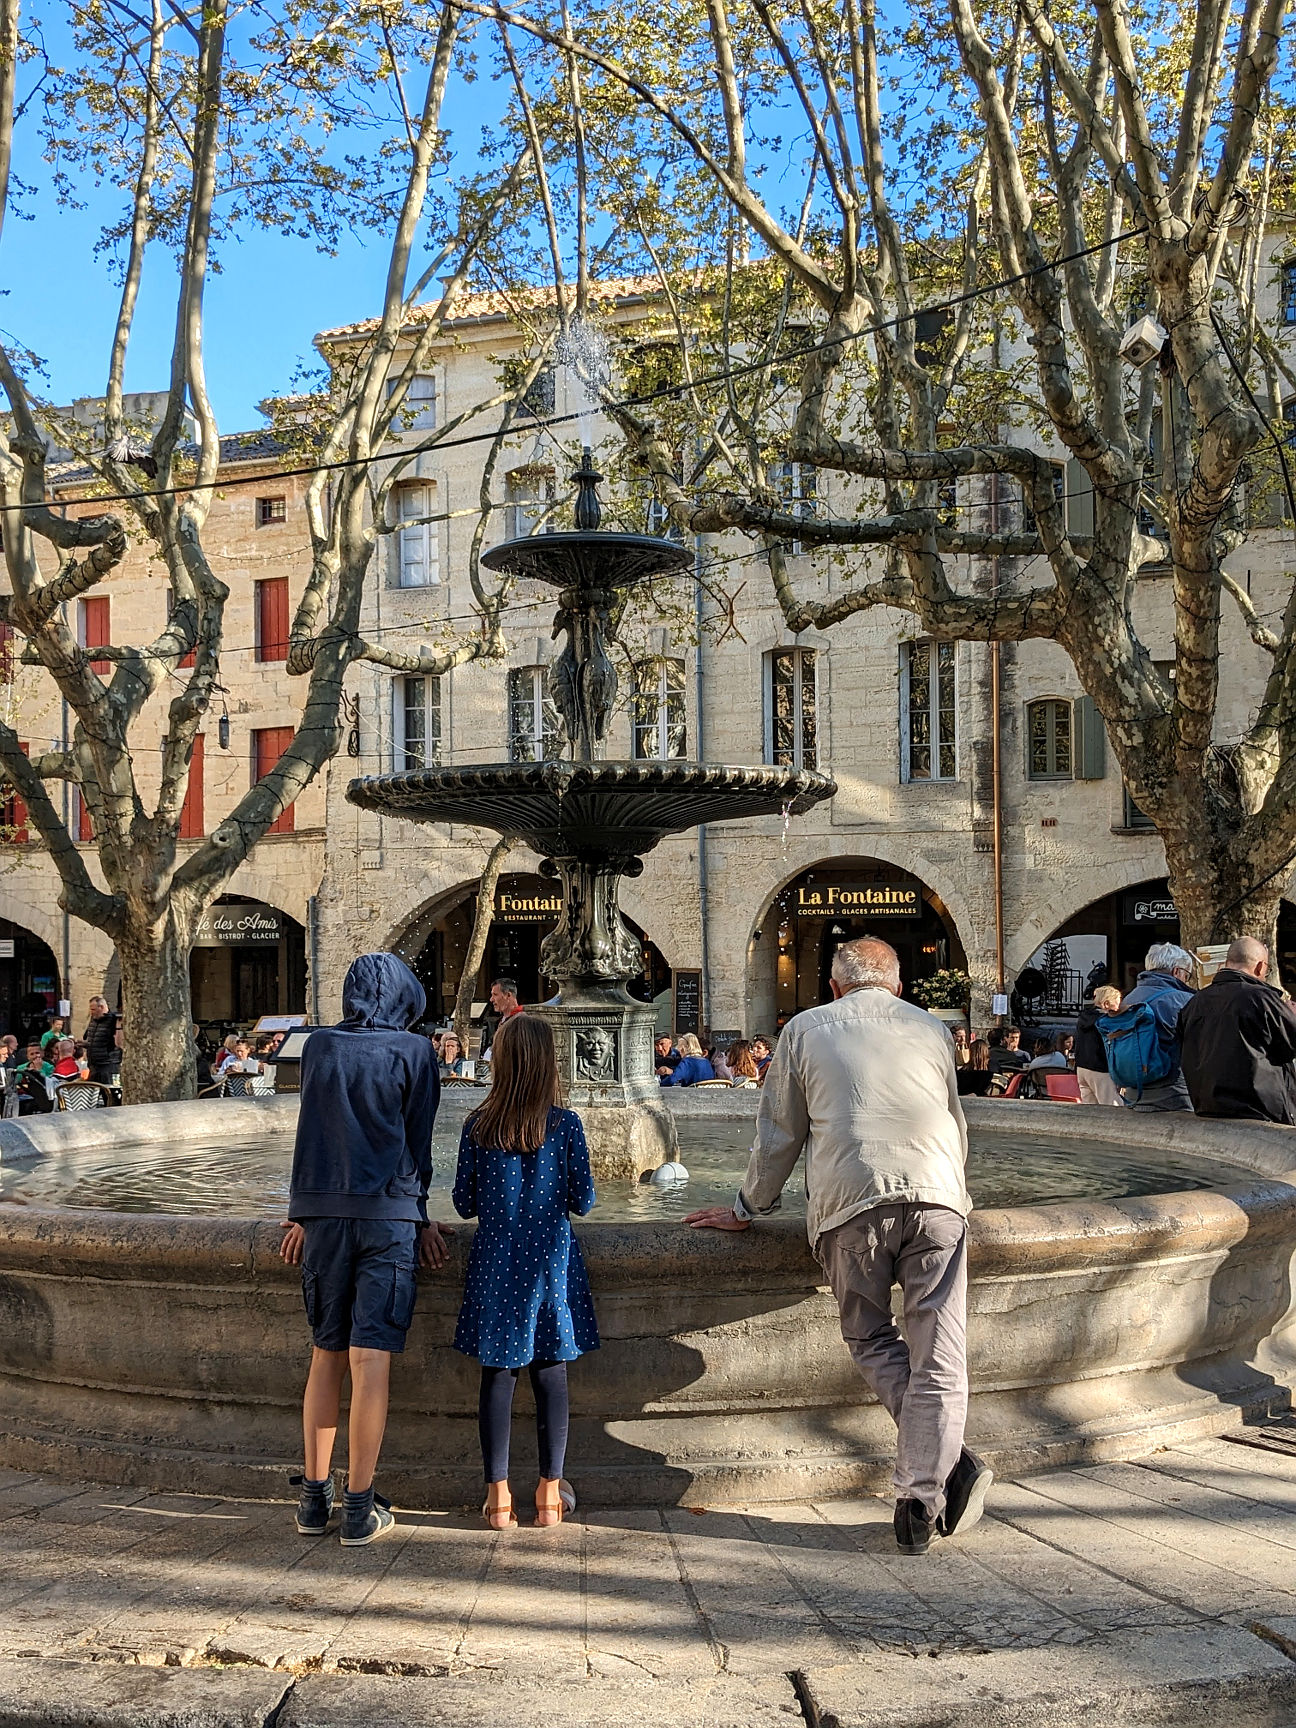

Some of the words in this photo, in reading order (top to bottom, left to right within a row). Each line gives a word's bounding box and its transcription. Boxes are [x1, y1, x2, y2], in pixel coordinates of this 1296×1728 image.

[798, 887, 822, 905] La
[826, 887, 916, 905] Fontaine
[870, 907, 917, 915] ARTISANALES
[213, 914, 234, 930] des
[236, 912, 278, 931] Amis
[251, 932, 280, 940] GLACIER
